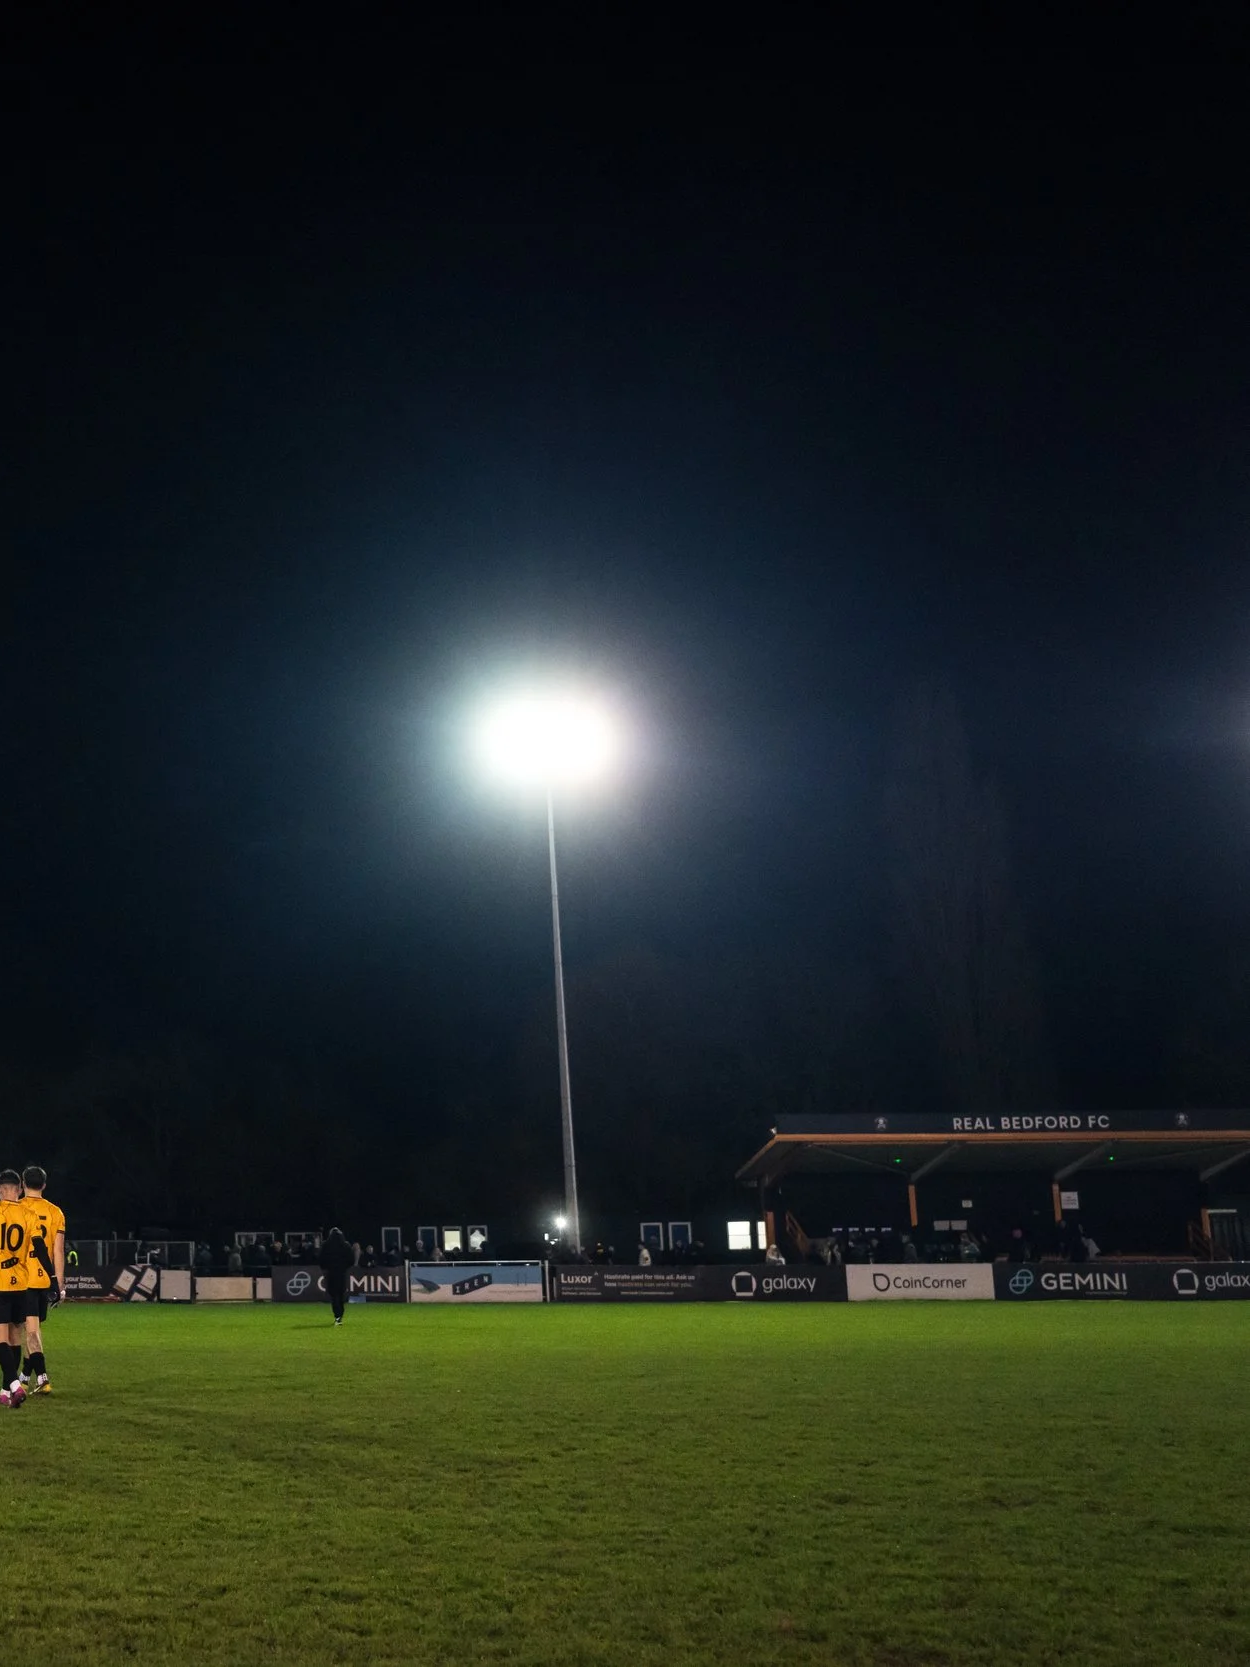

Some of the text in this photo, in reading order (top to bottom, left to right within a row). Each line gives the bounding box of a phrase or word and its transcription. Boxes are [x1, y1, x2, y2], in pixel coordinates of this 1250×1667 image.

[953, 1115, 1110, 1130] REAL BEDFORD FC
[0, 1222, 24, 1252] 10
[456, 1275, 489, 1293] IREN
[560, 1273, 592, 1284] Luxor
[762, 1276, 817, 1293] galaxy
[893, 1276, 967, 1289] CoinCorner
[1041, 1273, 1128, 1290] GEMINI
[1205, 1271, 1250, 1291] galax
